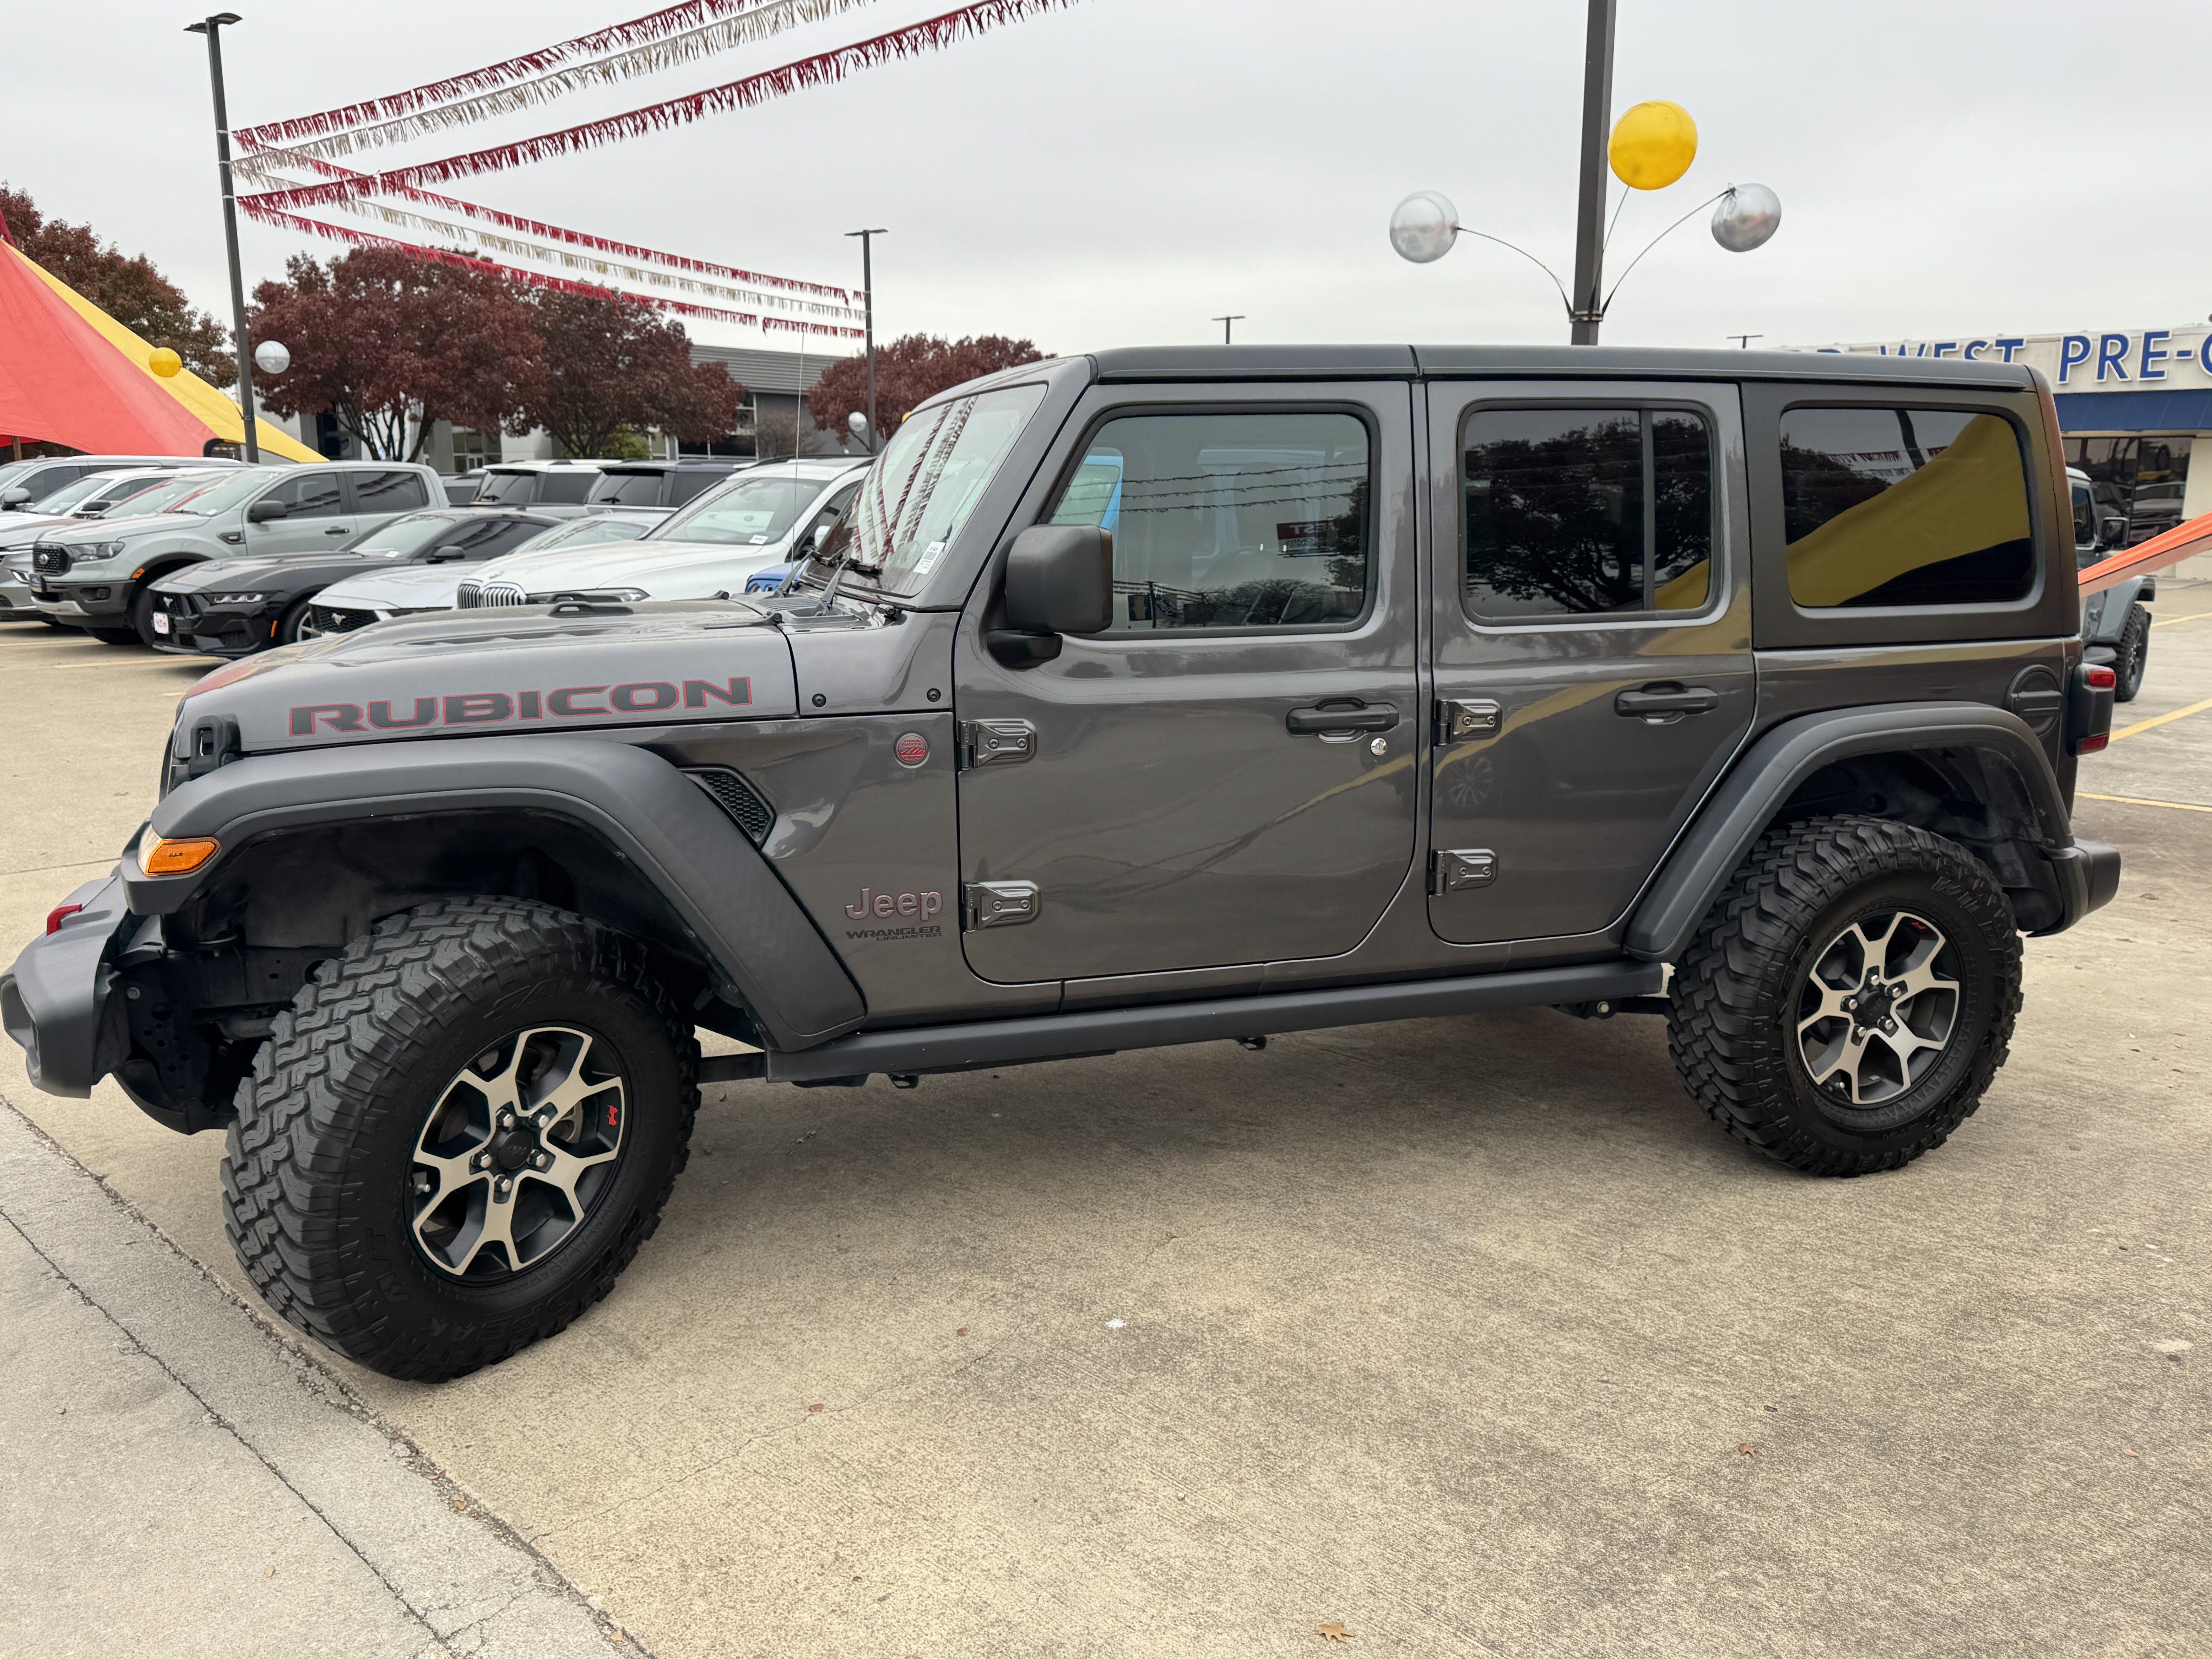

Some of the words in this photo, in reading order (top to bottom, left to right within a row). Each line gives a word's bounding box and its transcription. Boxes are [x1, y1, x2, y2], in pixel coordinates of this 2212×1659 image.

[2057, 330, 2212, 384] PRE-
[288, 676, 753, 737] RUBICON
[845, 887, 943, 921] Jeep
[845, 926, 941, 939] WRANGLER
[877, 933, 942, 941] UNLIMITED
